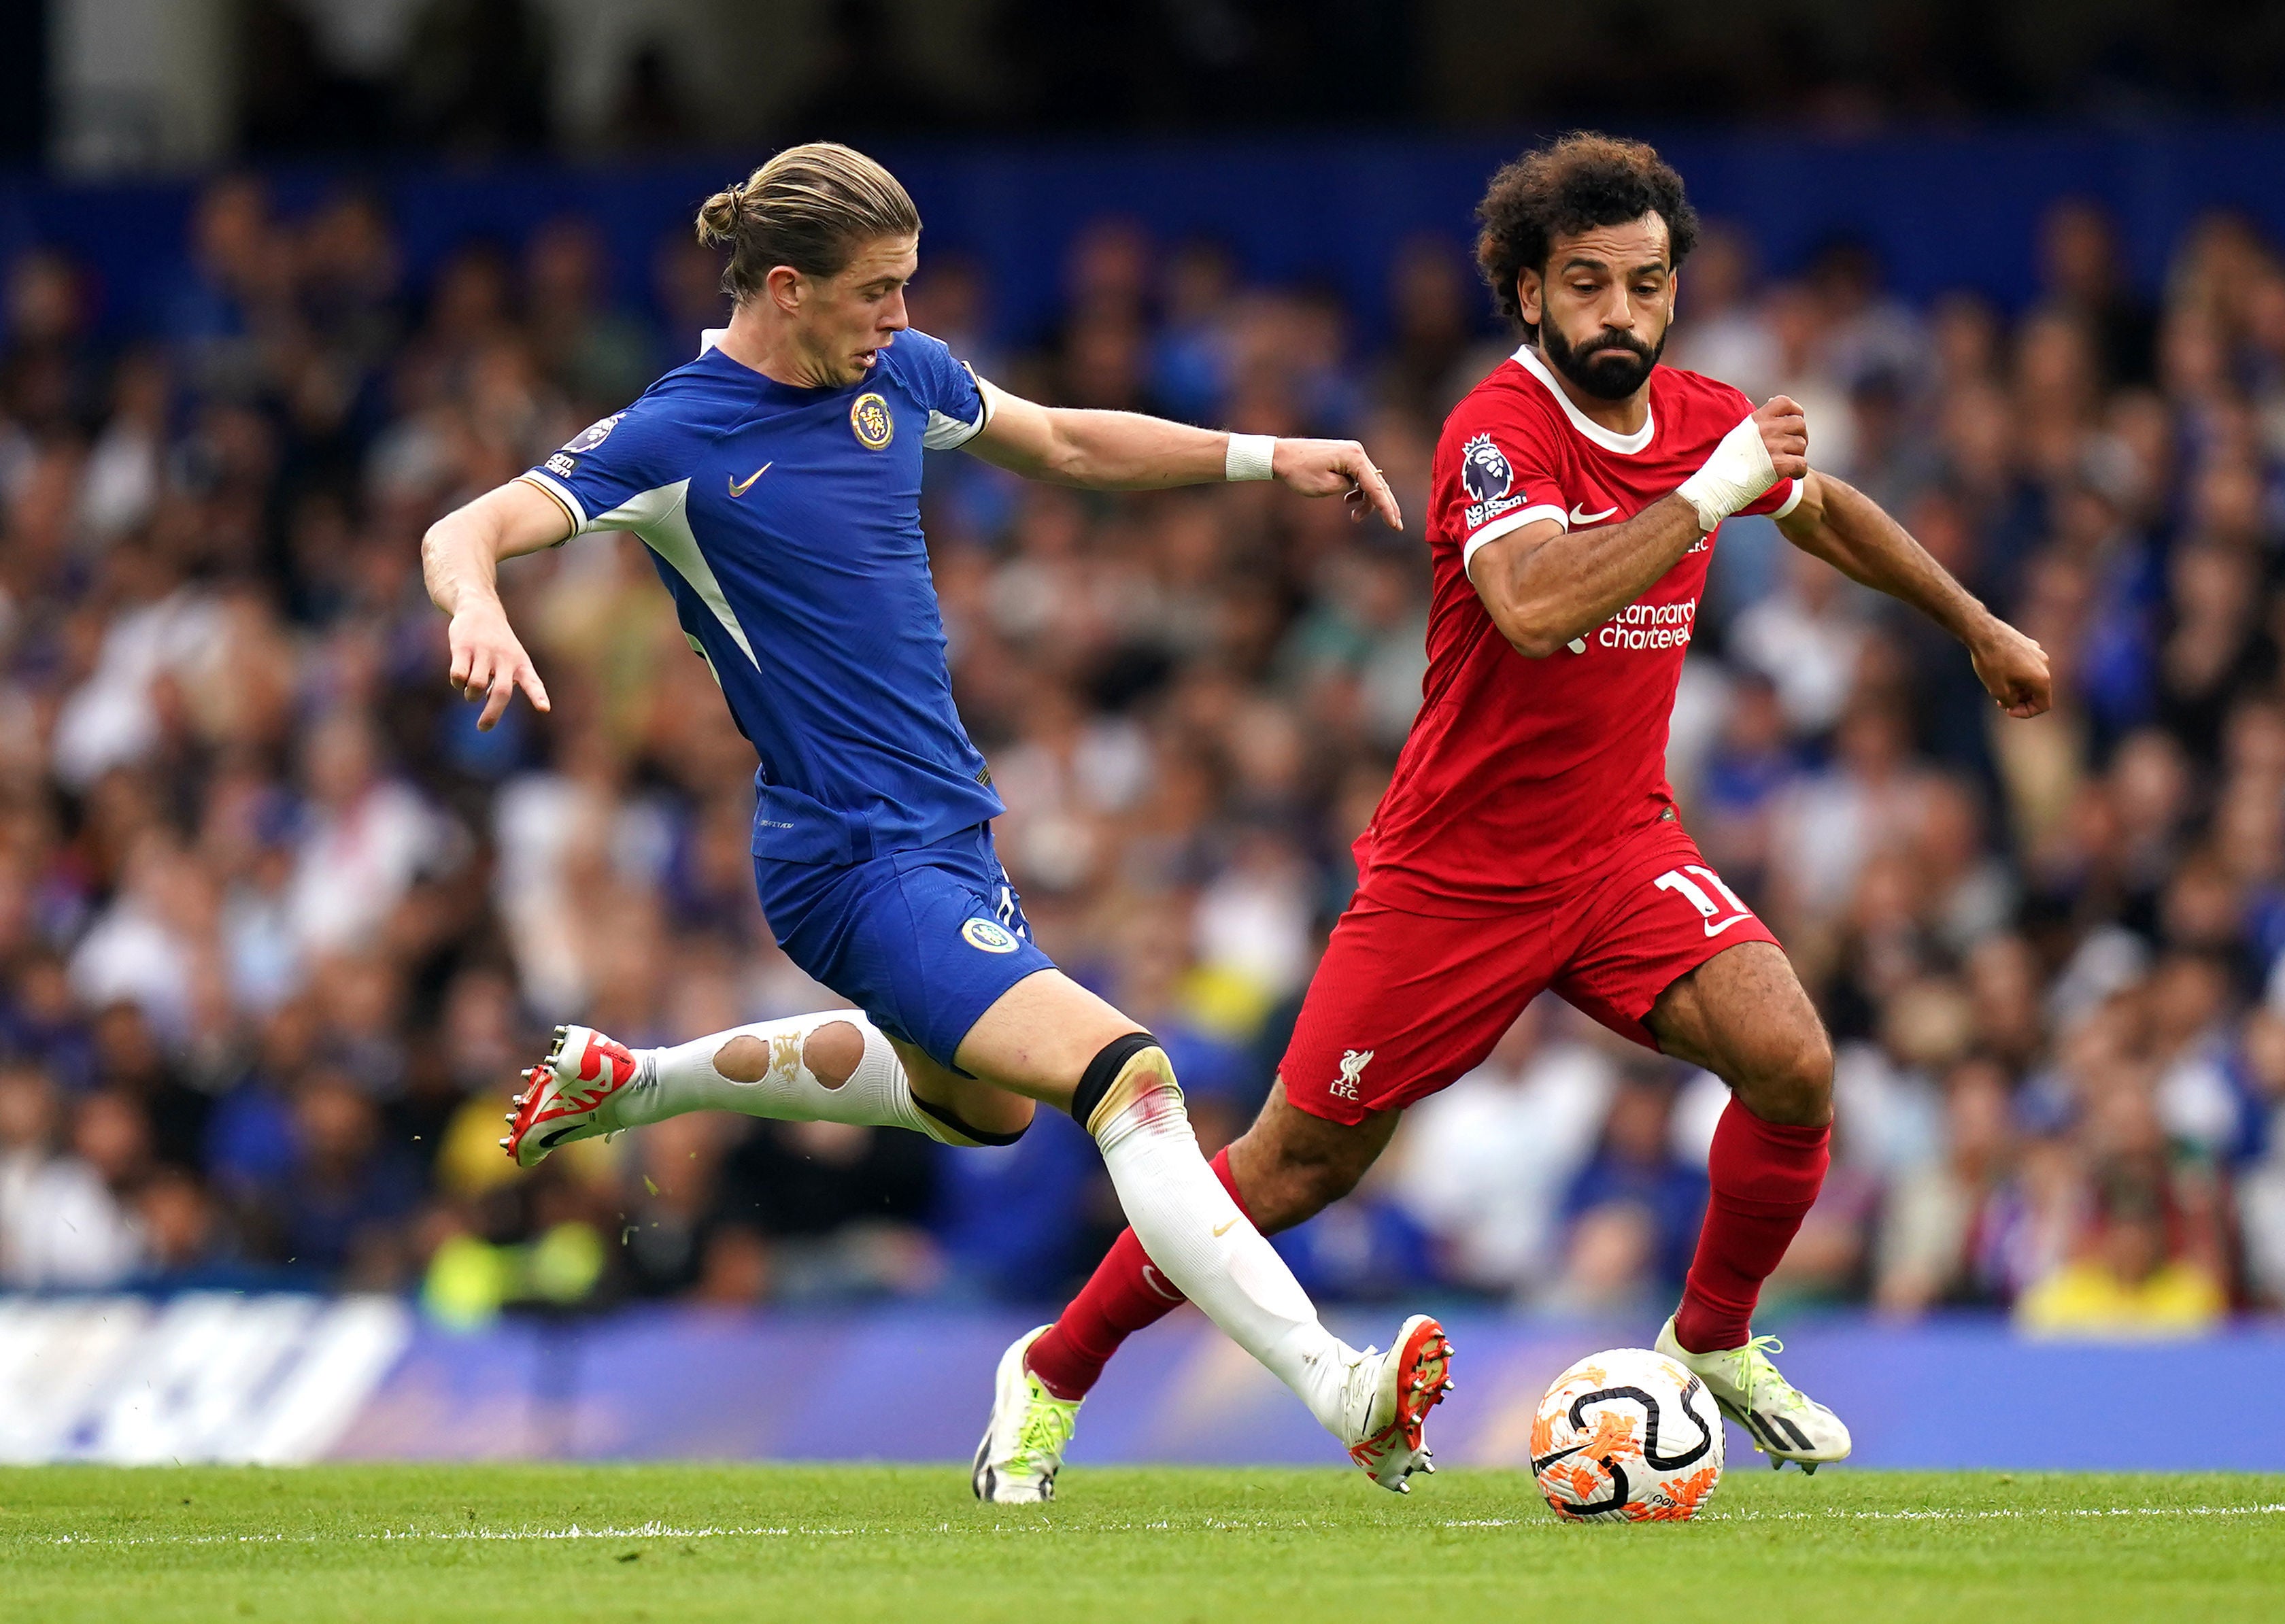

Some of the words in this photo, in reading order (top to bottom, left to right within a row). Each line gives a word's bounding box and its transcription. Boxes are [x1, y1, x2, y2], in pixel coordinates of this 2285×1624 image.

[1465, 505, 1483, 520] No
[1608, 597, 1695, 625] tandard
[1653, 864, 1748, 918] 11
